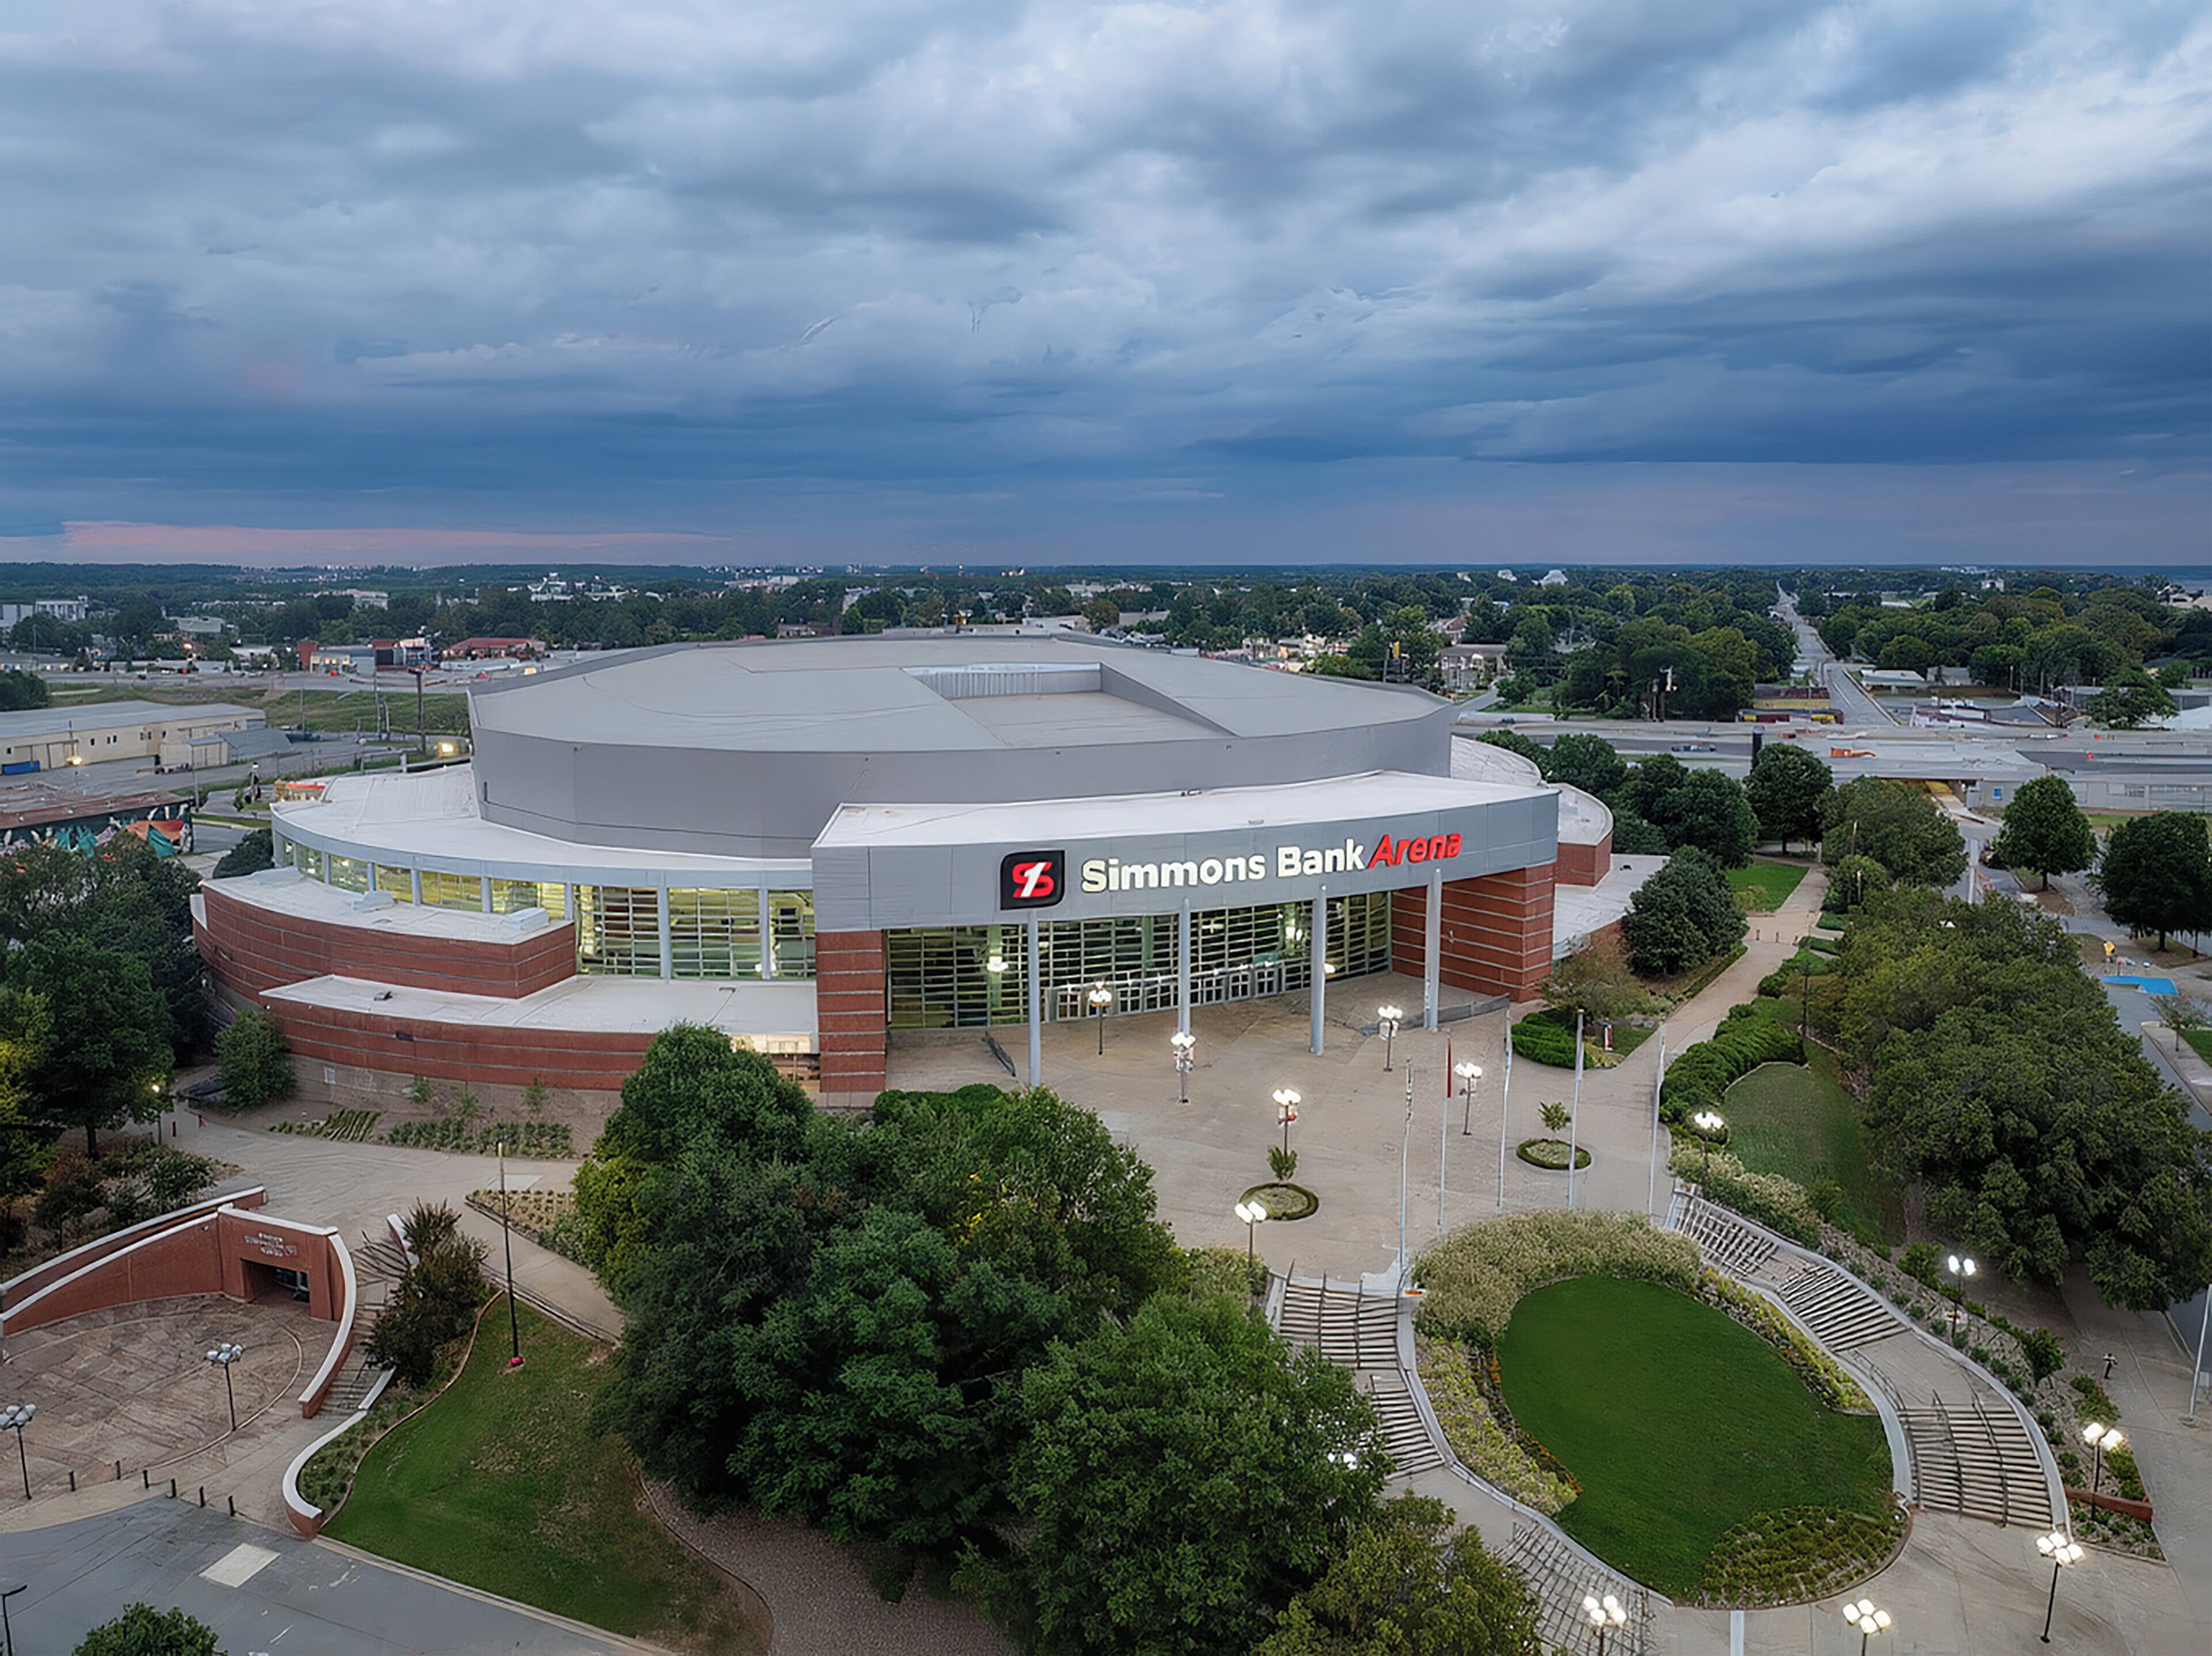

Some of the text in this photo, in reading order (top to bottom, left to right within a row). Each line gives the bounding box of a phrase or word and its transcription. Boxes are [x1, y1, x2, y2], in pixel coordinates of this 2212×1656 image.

[1081, 833, 1463, 893] Simmons Bank Arena
